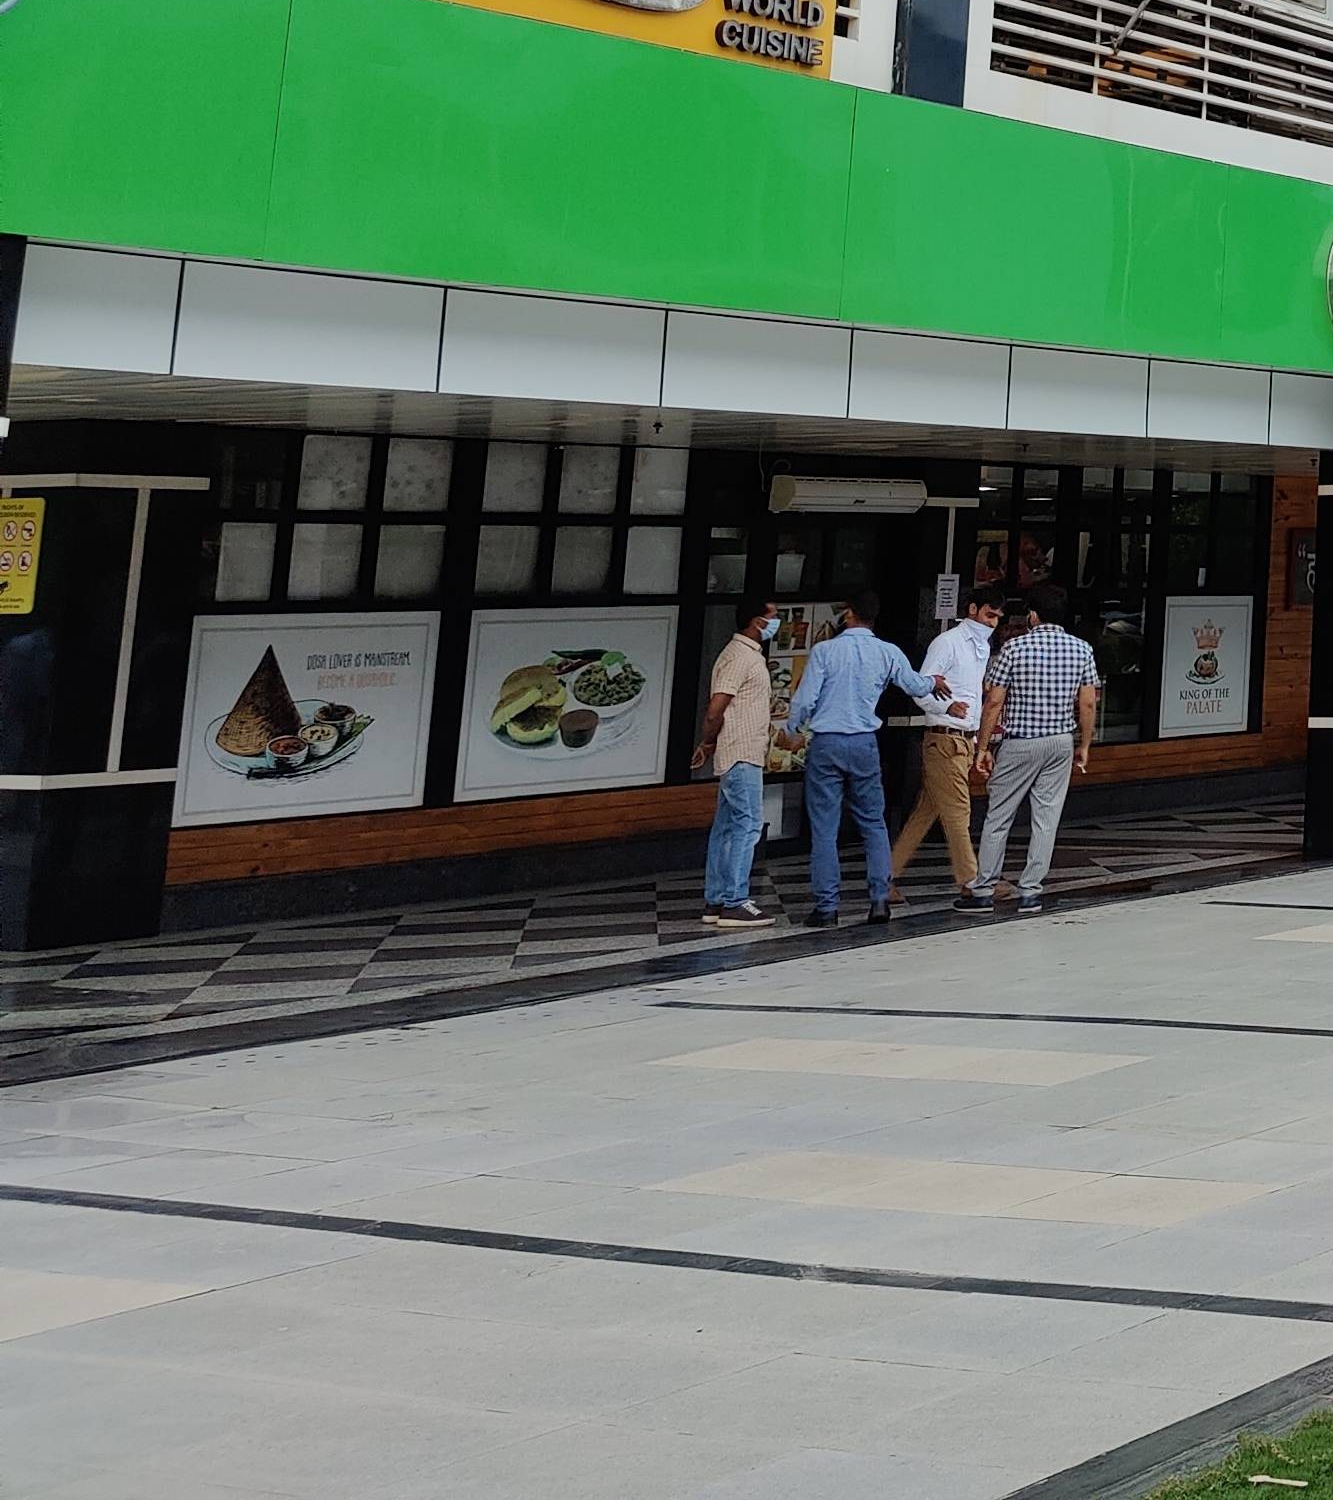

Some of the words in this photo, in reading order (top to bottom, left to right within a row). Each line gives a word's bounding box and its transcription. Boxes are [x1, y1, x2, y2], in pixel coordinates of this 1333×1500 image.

[715, 18, 825, 67] CUISINE
[306, 654, 327, 671] DOSA
[328, 653, 353, 670] LOVER
[354, 652, 362, 668] IS
[1179, 688, 1200, 701] KING
[1201, 688, 1212, 699] OF
[1214, 687, 1231, 699] THE
[1186, 699, 1222, 715] PALATE
